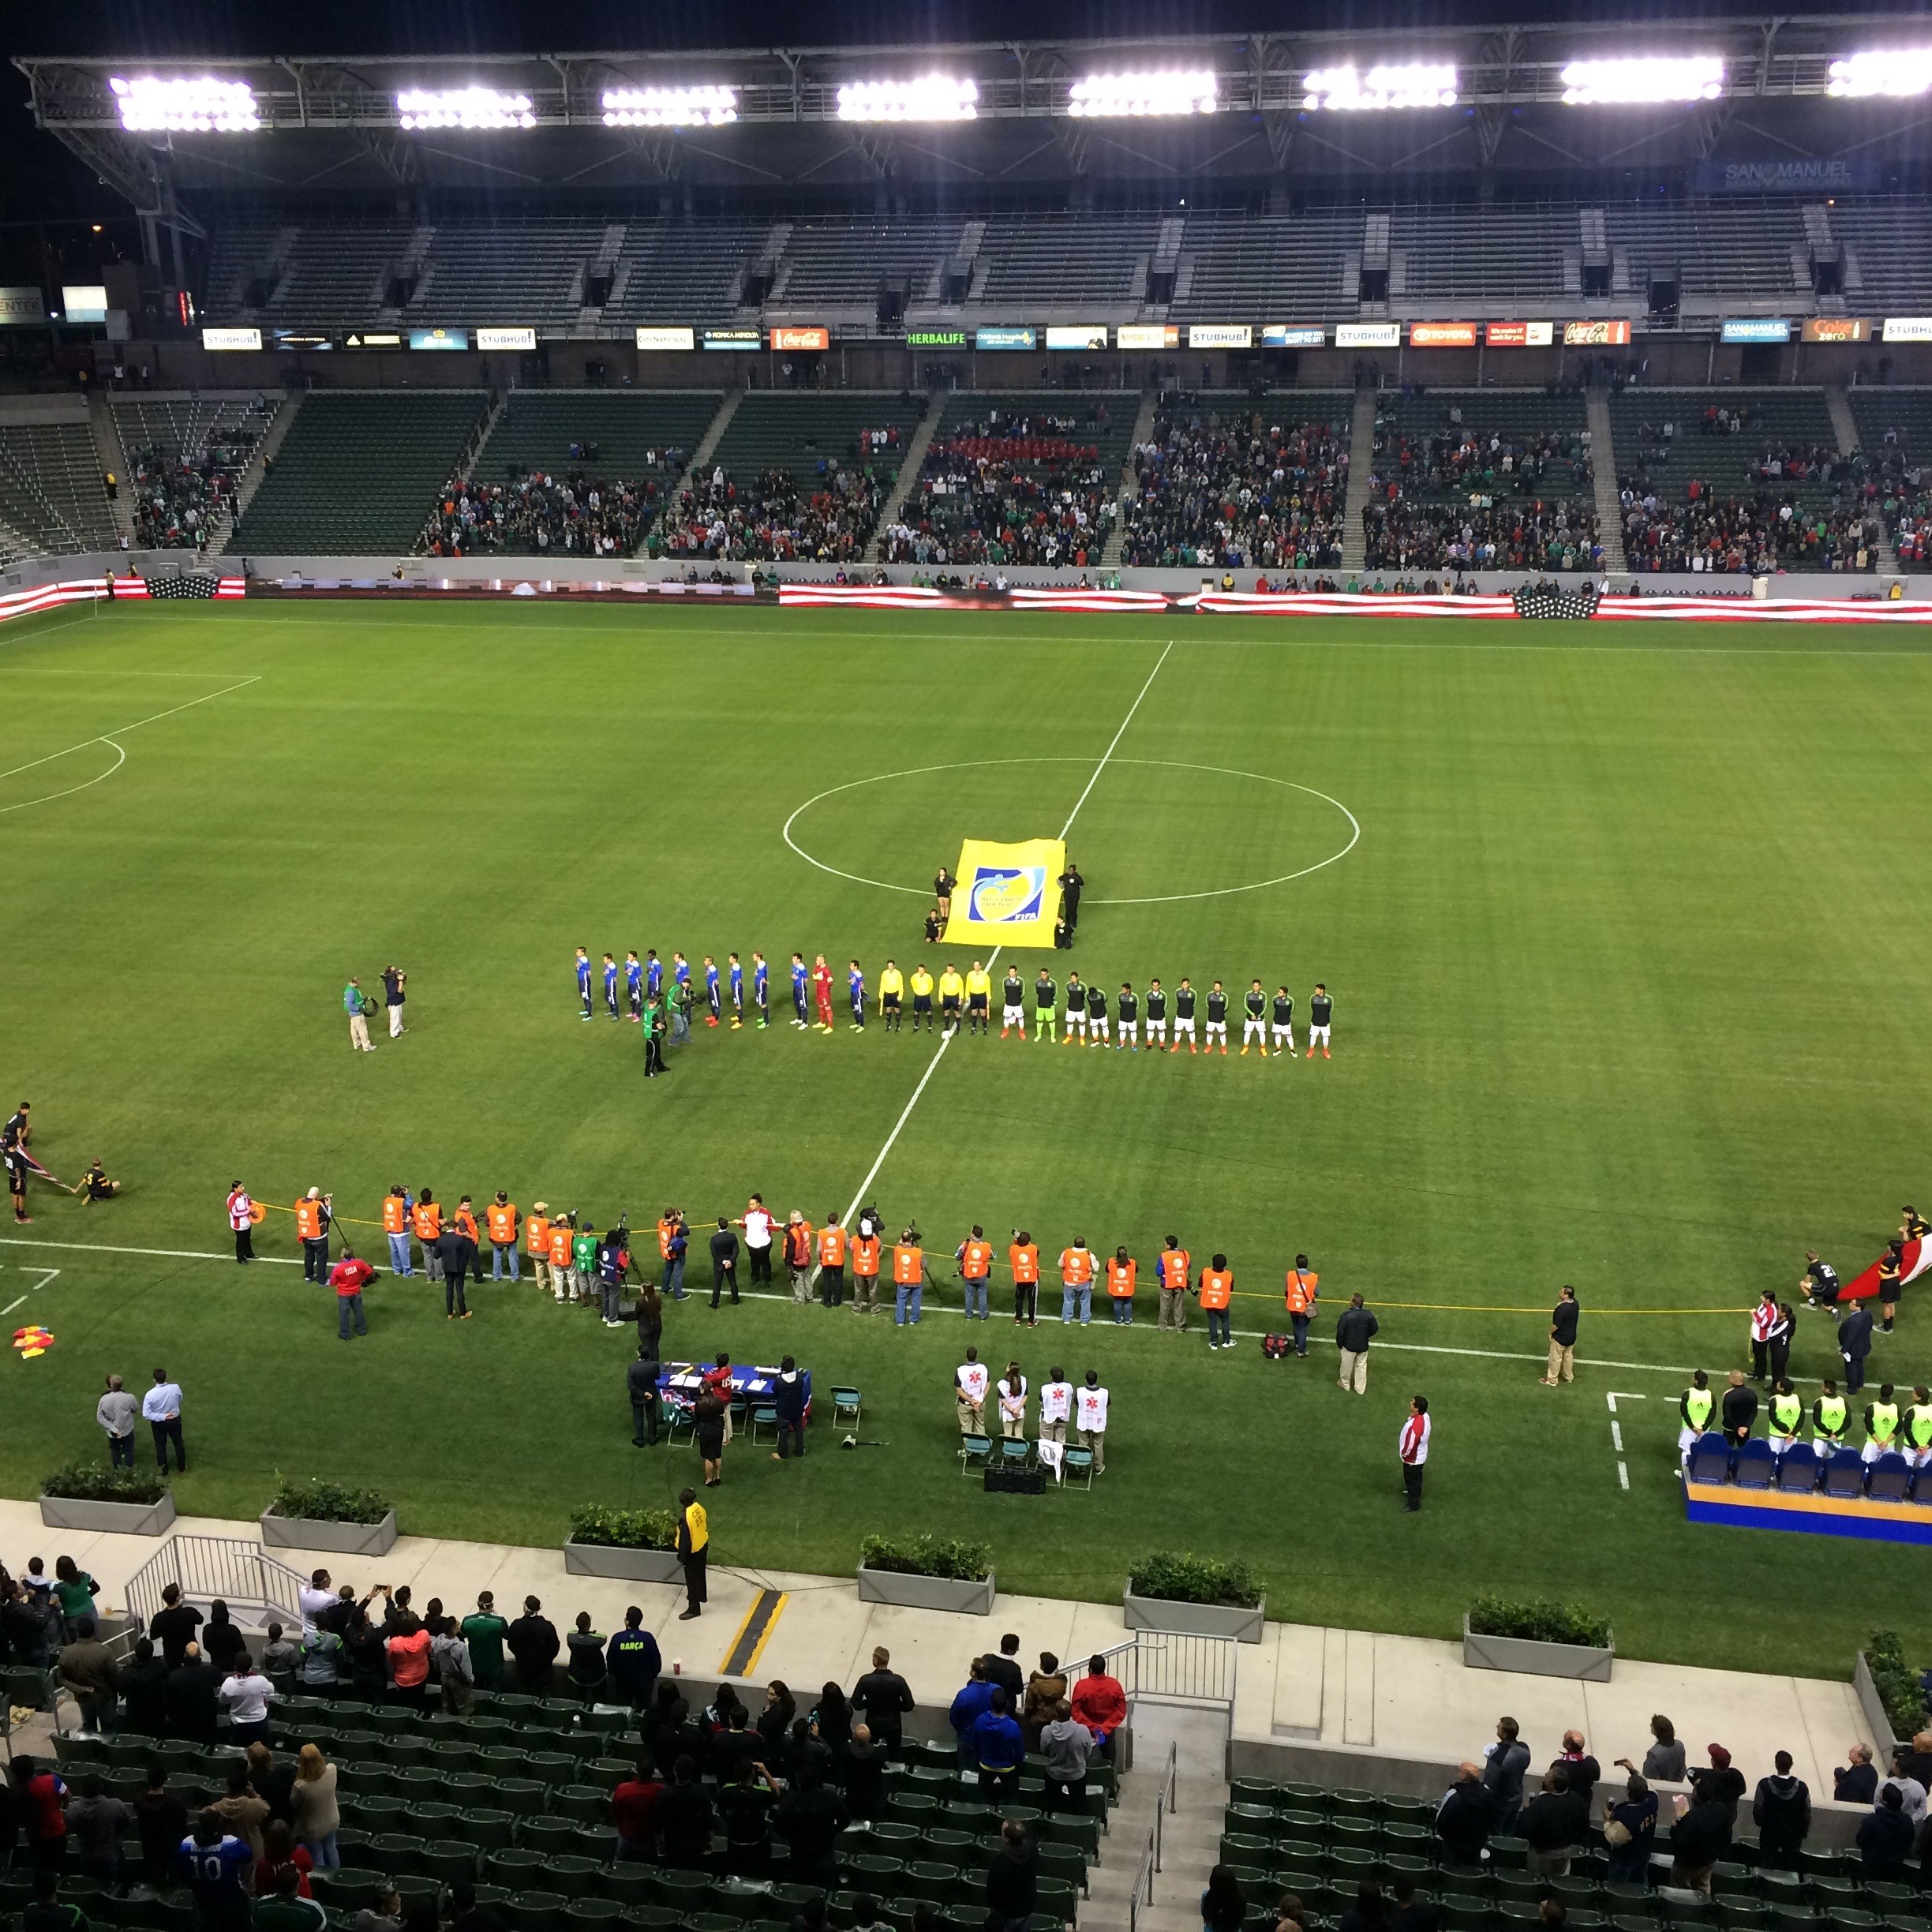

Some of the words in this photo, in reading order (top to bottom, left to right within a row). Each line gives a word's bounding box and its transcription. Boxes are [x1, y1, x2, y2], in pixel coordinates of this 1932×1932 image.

[1726, 163, 1763, 180] SAN
[1777, 161, 1852, 178] MANUEL
[1340, 327, 1395, 339] STUBHUB!
[1814, 320, 1853, 334] Coke
[208, 331, 257, 343] STUBHUB!
[481, 331, 531, 343] STUBHUB!
[908, 333, 965, 344] HERBALIFE
[1194, 328, 1248, 341] STUBHUB!
[1431, 330, 1473, 339] TOYOTA
[1819, 332, 1846, 341] zero
[1015, 912, 1037, 921] FIFA
[87, 1174, 93, 1185] 5
[345, 1265, 358, 1275] USA
[1821, 1265, 1836, 1278] 21
[620, 1642, 643, 1650] BARÇA
[190, 1855, 222, 1880] 10
